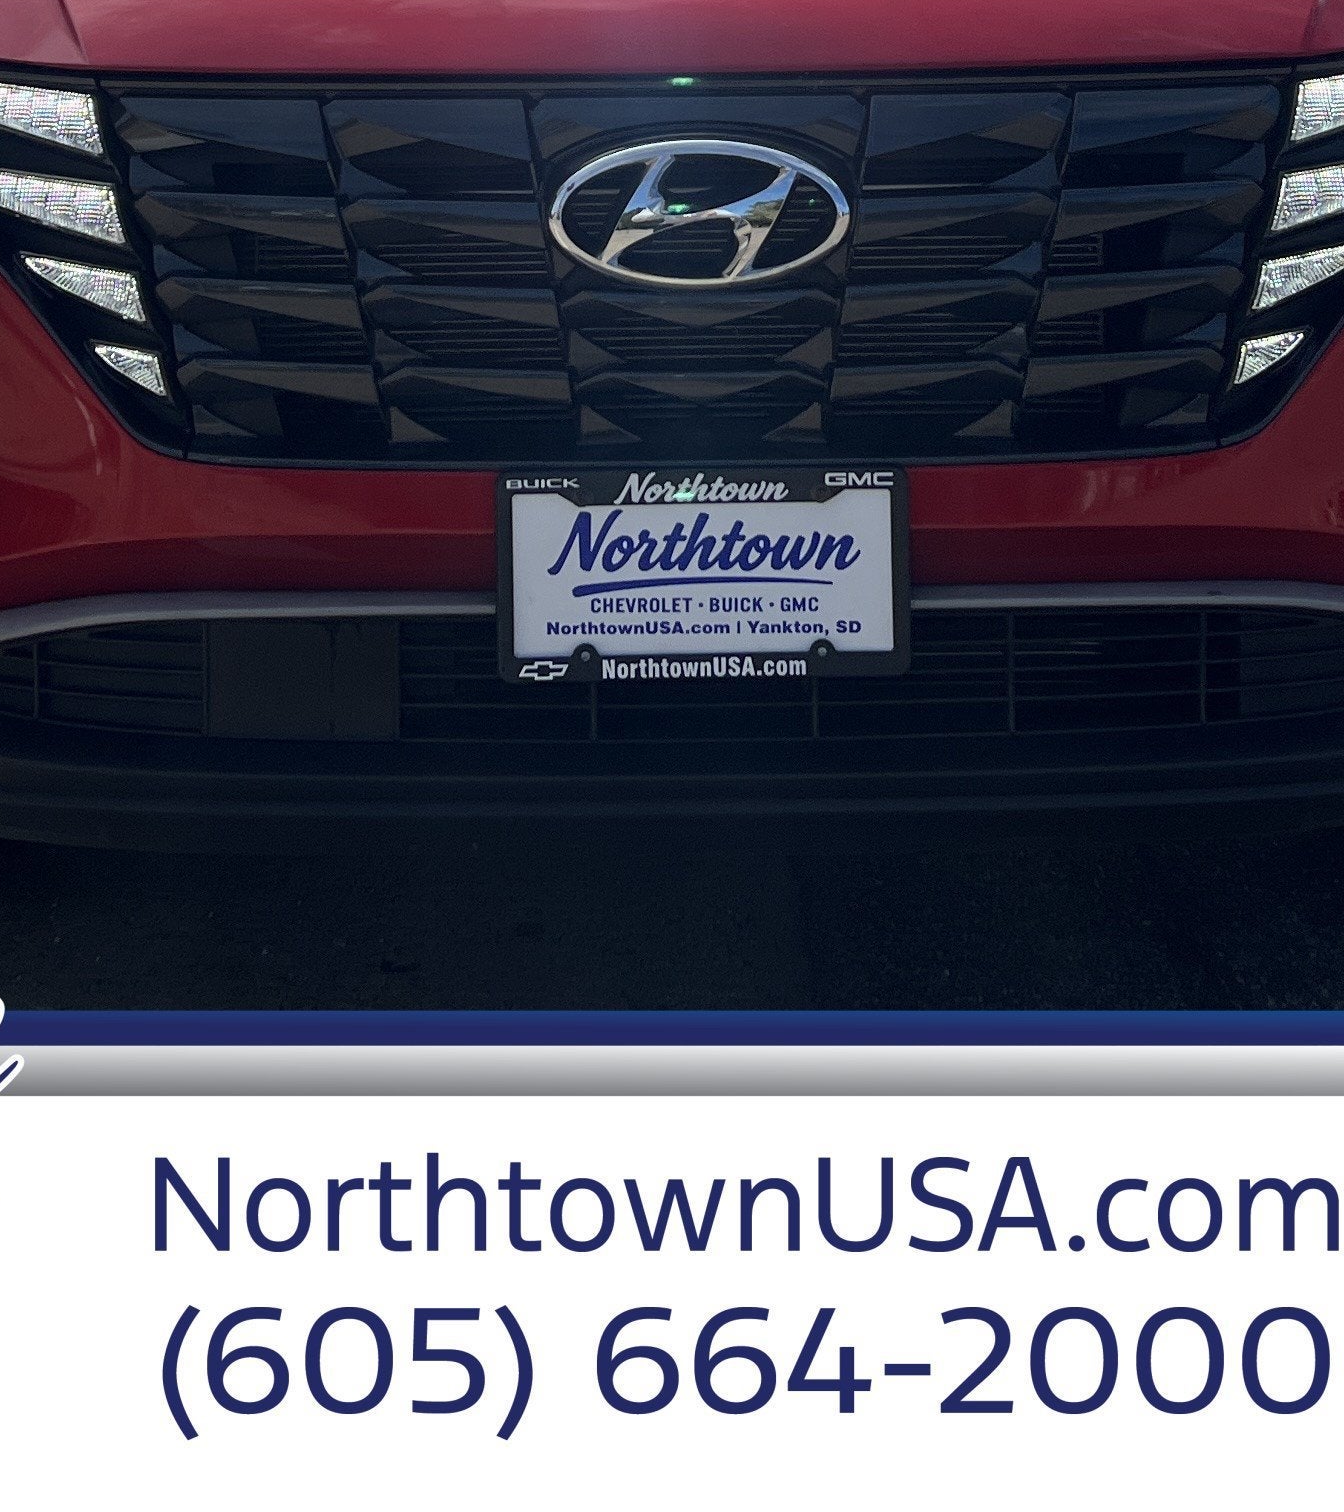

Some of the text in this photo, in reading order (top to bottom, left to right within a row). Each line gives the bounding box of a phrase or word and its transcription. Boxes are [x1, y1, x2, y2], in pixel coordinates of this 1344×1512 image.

[505, 477, 581, 490] BUICK
[824, 471, 895, 487] GMC
[613, 472, 789, 505] Northtown
[547, 508, 861, 576] Northtown
[590, 596, 820, 614] CHEVROLET BUICK GMC
[546, 620, 731, 635] NorthtownUSA.com
[747, 620, 829, 636] Yankton,
[836, 619, 862, 634] SD
[601, 655, 807, 680] NorthtownUSA.com
